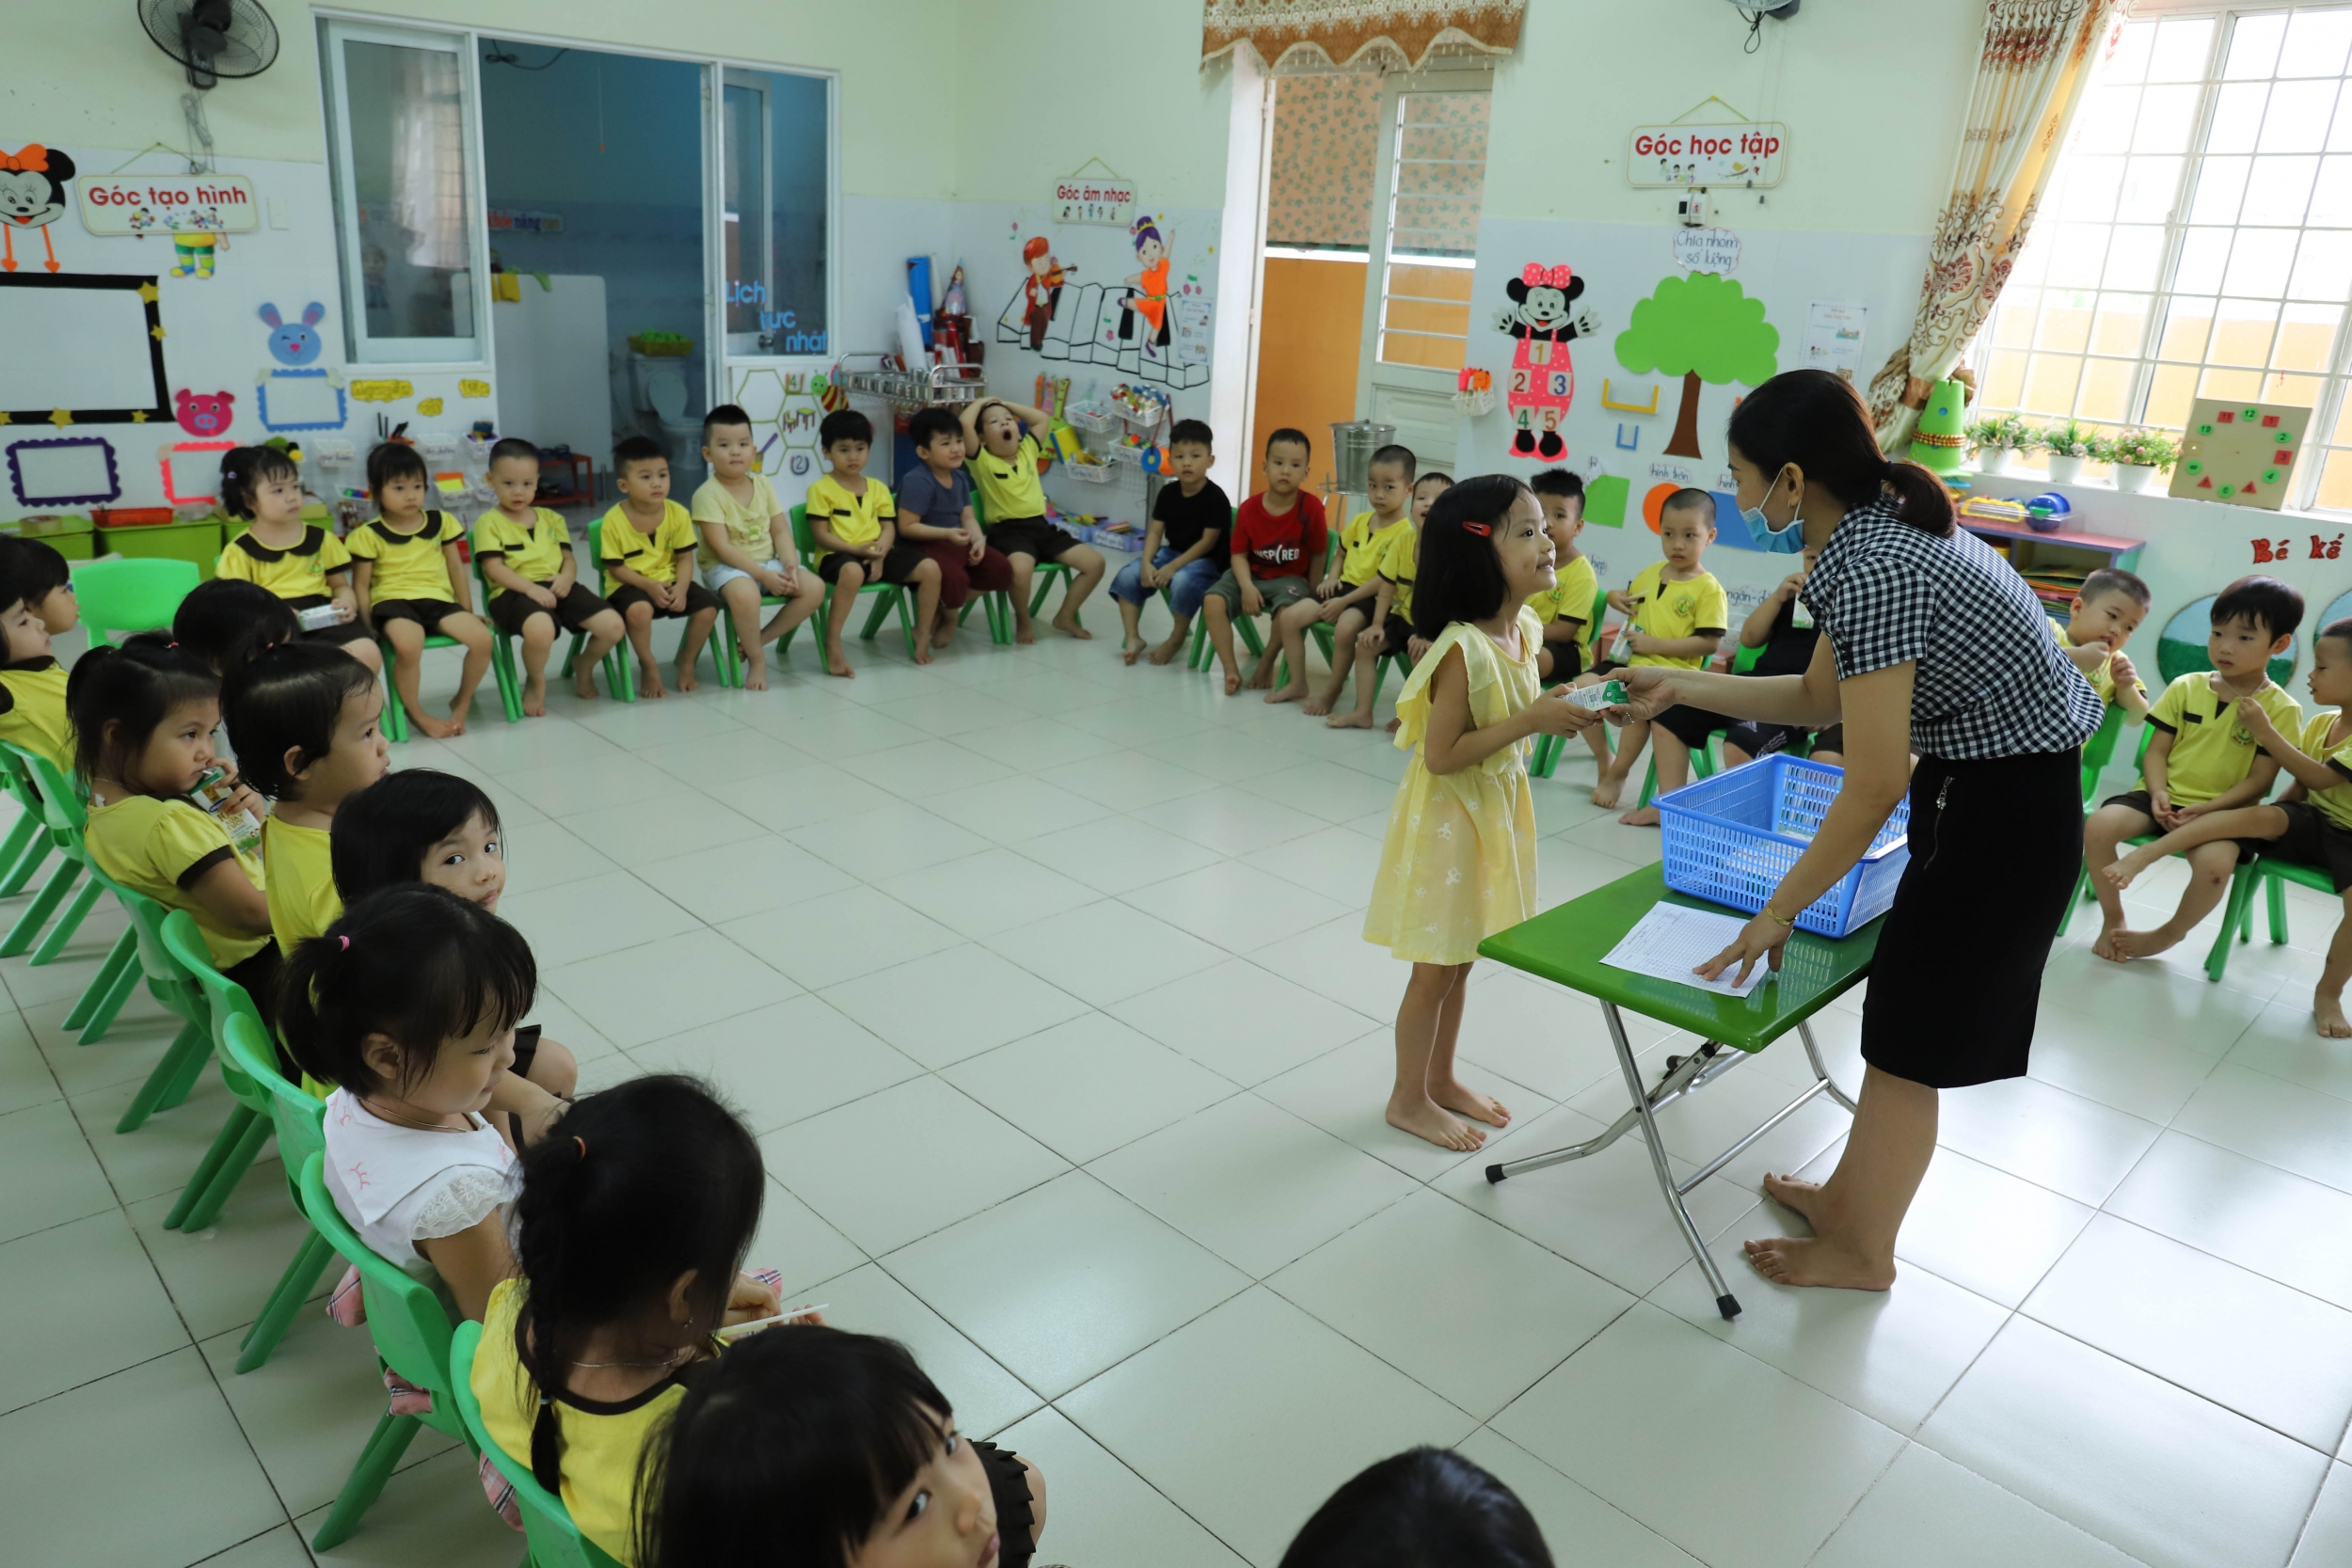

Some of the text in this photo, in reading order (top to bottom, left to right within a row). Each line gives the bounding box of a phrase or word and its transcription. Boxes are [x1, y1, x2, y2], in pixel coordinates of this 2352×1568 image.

[1635, 131, 1780, 161] Góc học tập
[88, 184, 247, 211] Góc tạo hình
[1057, 184, 1131, 207] Góc âm nhạc
[1677, 229, 1739, 248] Chia nhóm
[1685, 248, 1732, 272] số lượng
[725, 280, 767, 308] Lịch
[786, 330, 828, 356] nhật
[1535, 343, 1544, 363] 1
[1514, 372, 1566, 395] 2 3
[1518, 409, 1557, 431] 4 5
[795, 455, 803, 470] 2
[1651, 463, 1689, 481] hình tròn
[2223, 486, 2230, 495] 6
[2250, 532, 2344, 564] Bé kế
